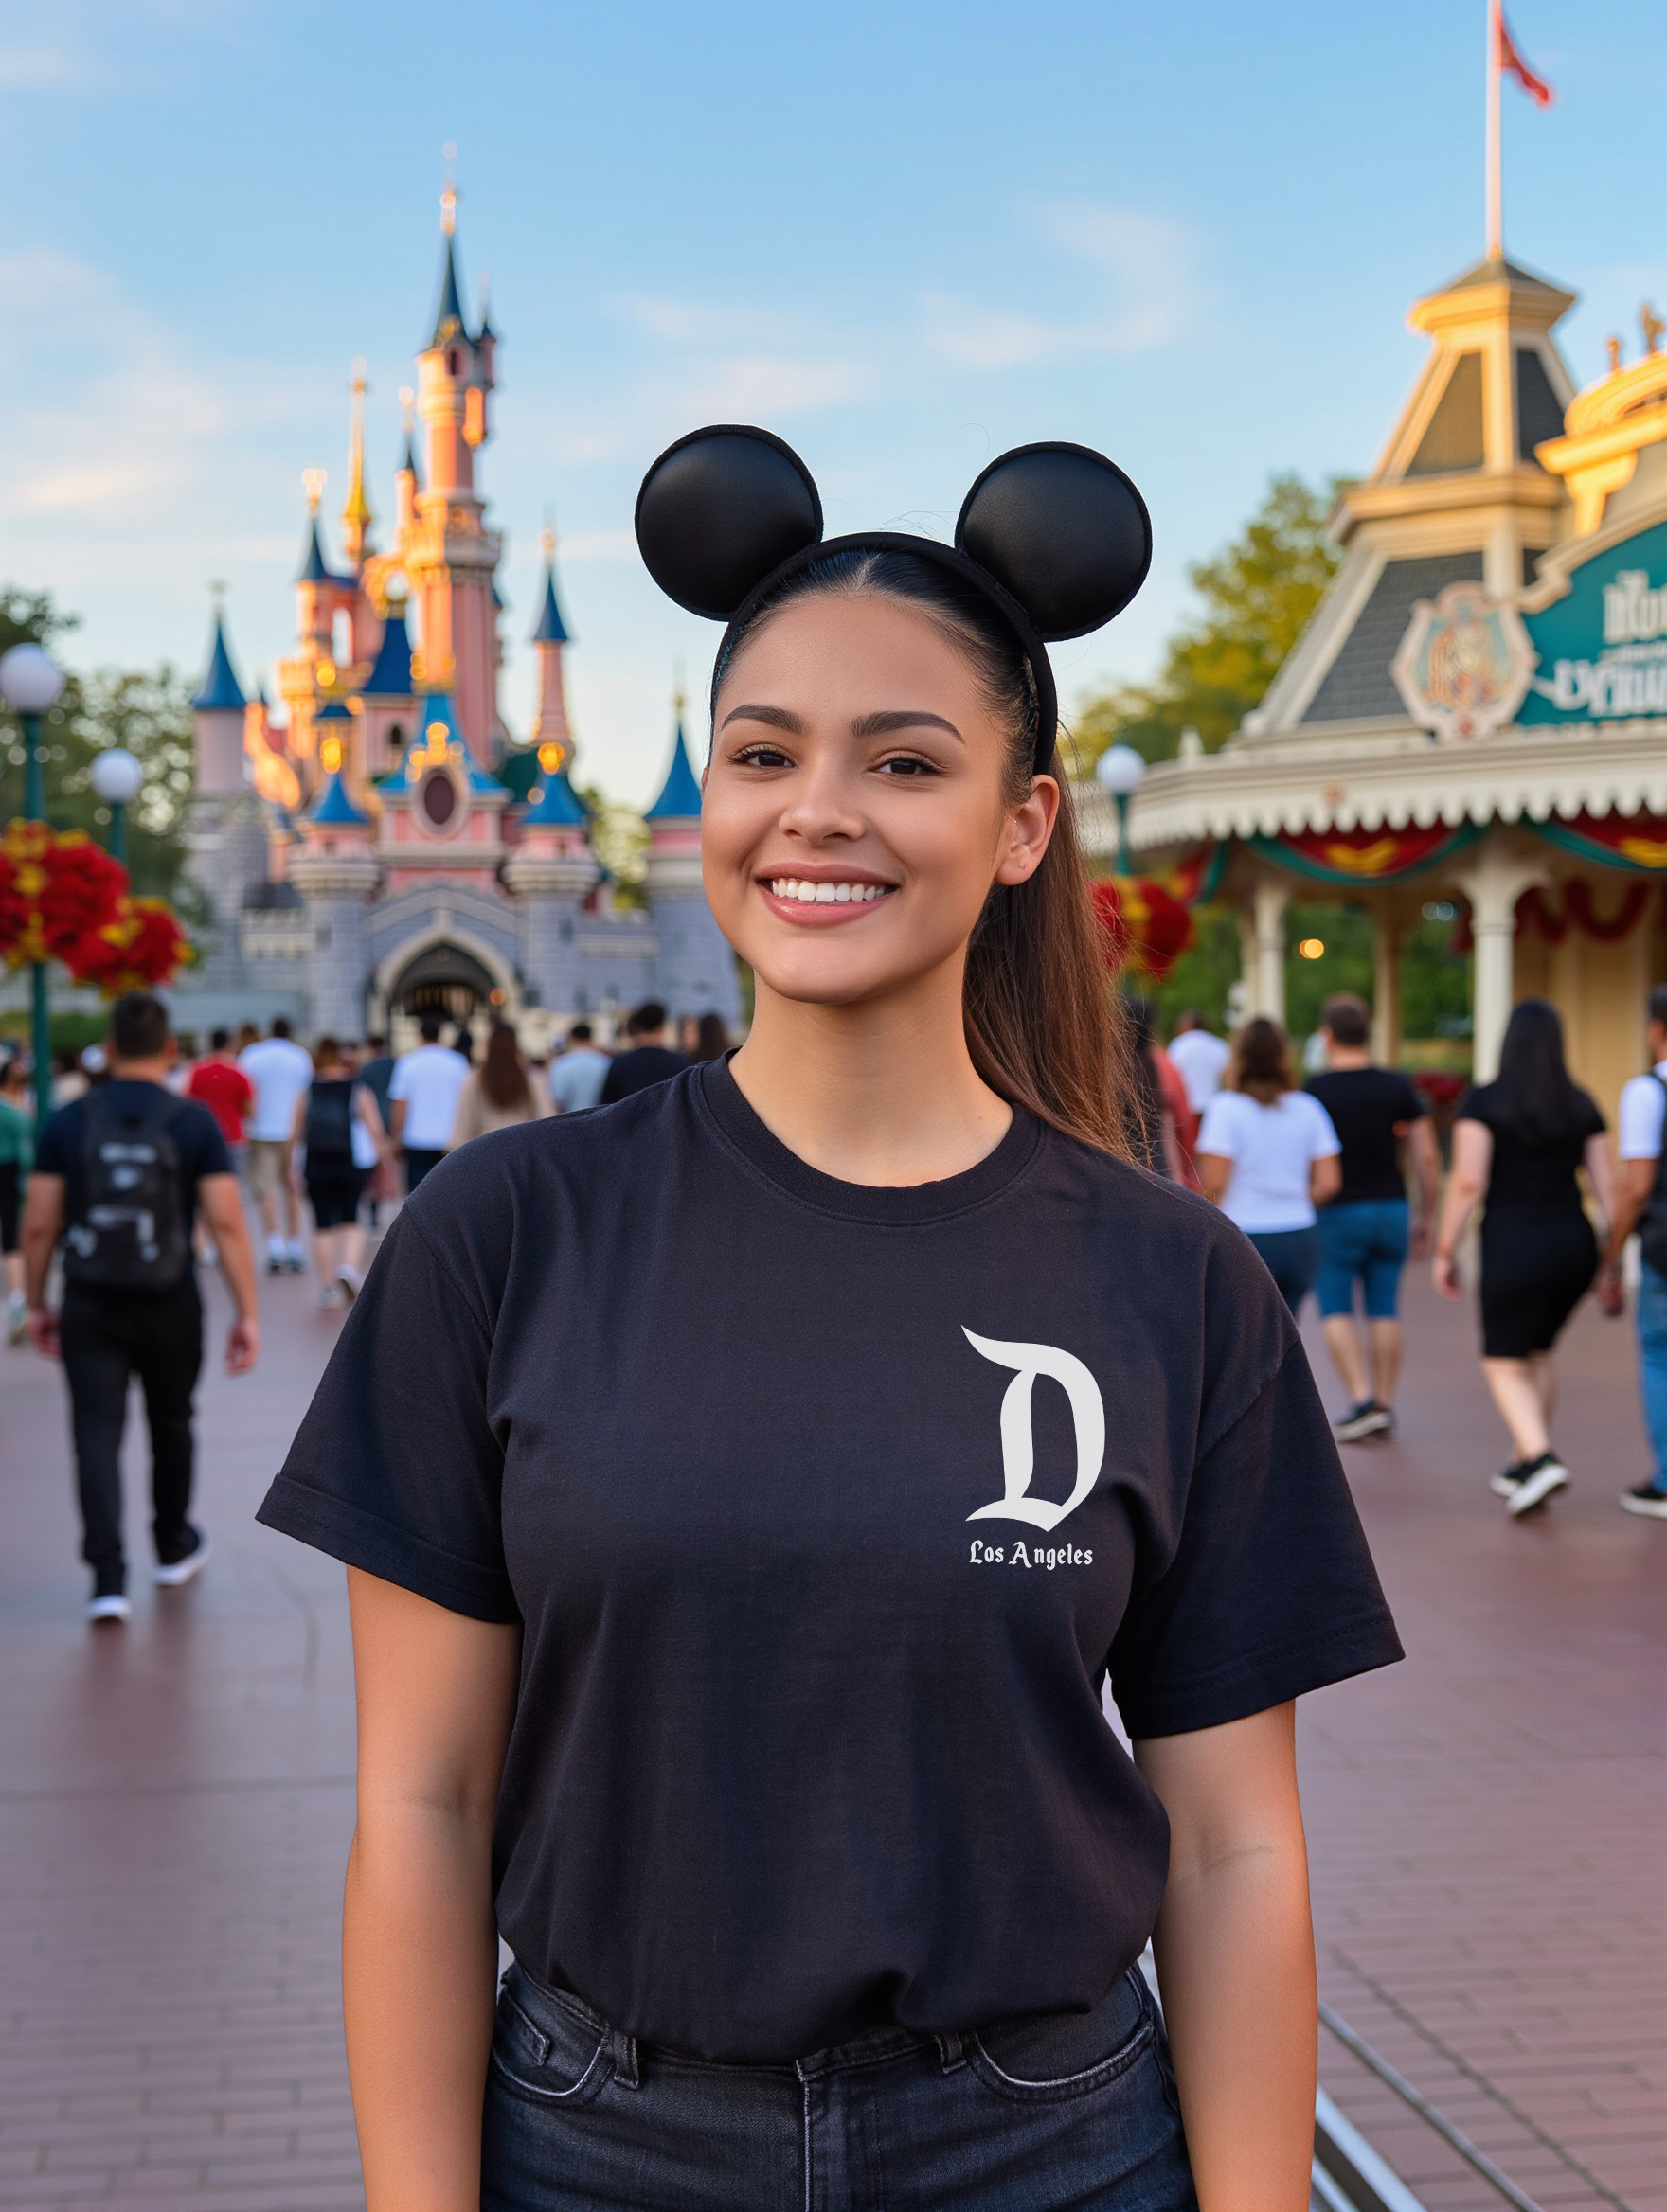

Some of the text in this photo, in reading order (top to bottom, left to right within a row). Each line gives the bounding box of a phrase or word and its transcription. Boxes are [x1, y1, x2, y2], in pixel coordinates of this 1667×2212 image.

[960, 1324, 1106, 1533] D
[969, 1539, 1094, 1571] Los Angeles
